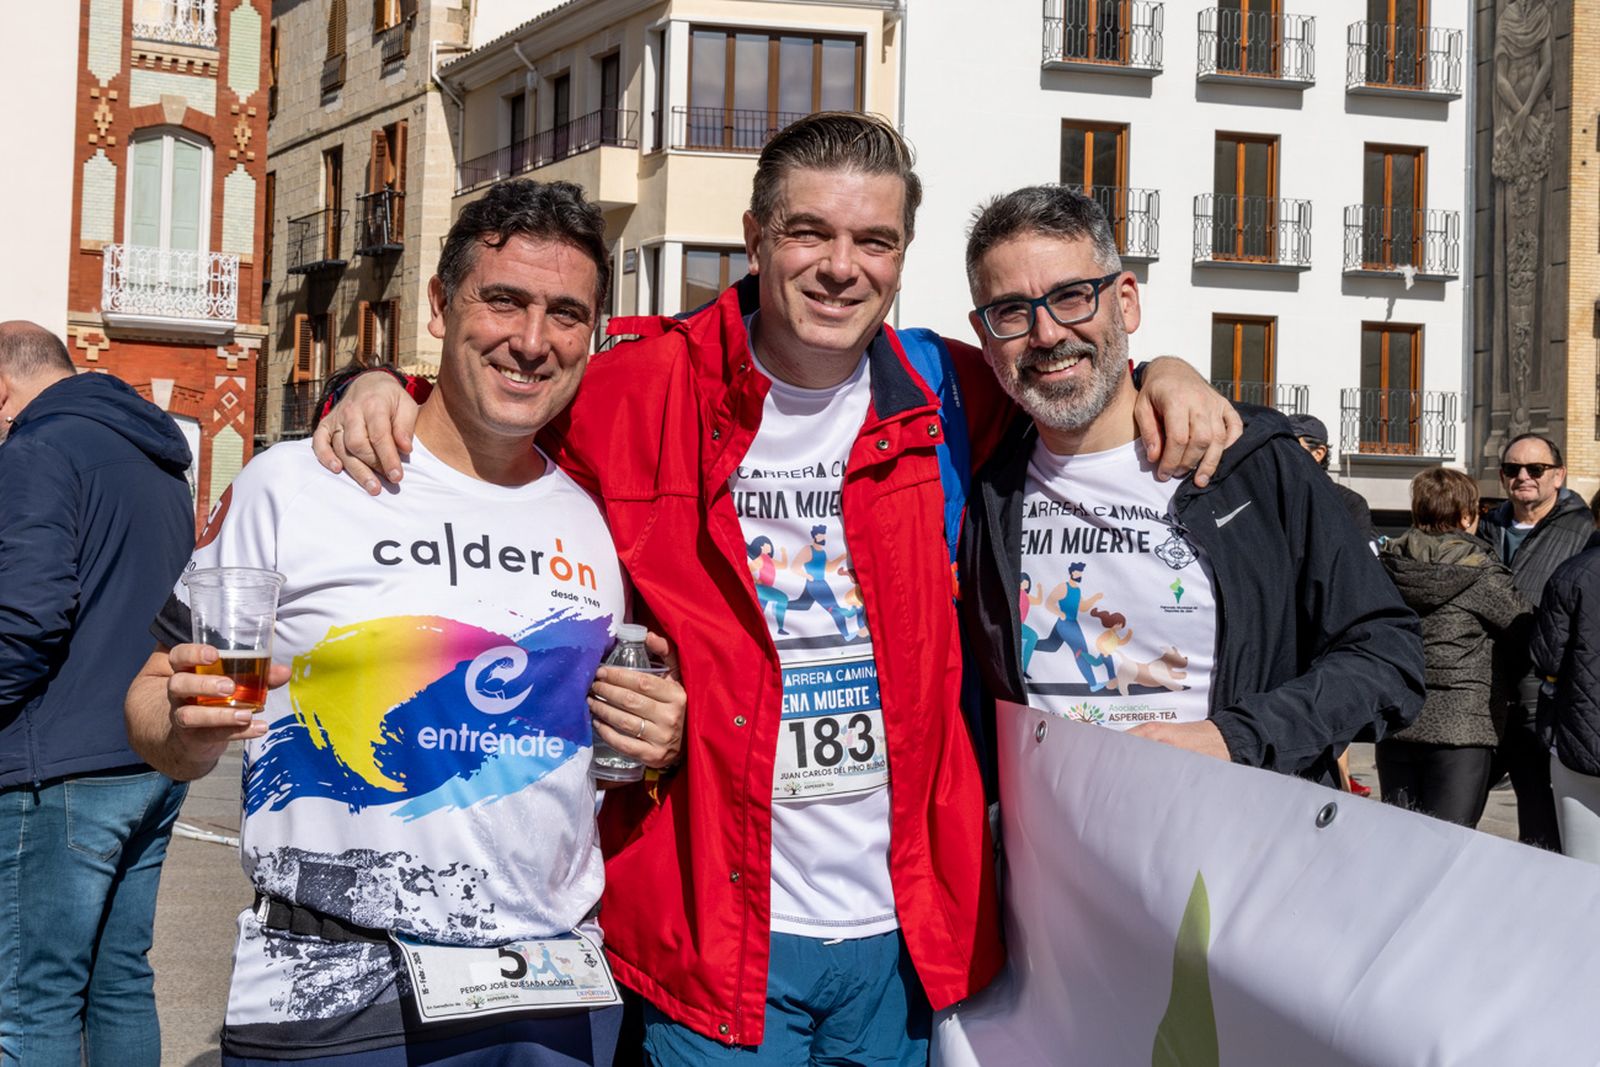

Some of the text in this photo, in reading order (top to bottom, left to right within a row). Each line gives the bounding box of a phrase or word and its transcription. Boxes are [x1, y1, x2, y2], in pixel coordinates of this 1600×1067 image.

[736, 461, 827, 479] CARRERA
[731, 490, 841, 519] UENA MUE
[1060, 526, 1150, 554] MUERTE
[372, 522, 598, 591] calderón
[550, 589, 579, 602] desde
[784, 671, 833, 687] ARRERA
[781, 686, 870, 713] ENA MUERTE
[1109, 703, 1150, 712] Asociación
[1108, 712, 1177, 722] ASPERGER-TEA
[417, 723, 564, 758] entrénate
[788, 713, 875, 769] 183
[780, 760, 886, 780] JUAN CARLOS DEL PINO BUENO
[498, 947, 527, 980] 5
[460, 984, 487, 995] PEDRO
[489, 980, 509, 991] JOSÉ
[510, 979, 545, 989] QUESADA
